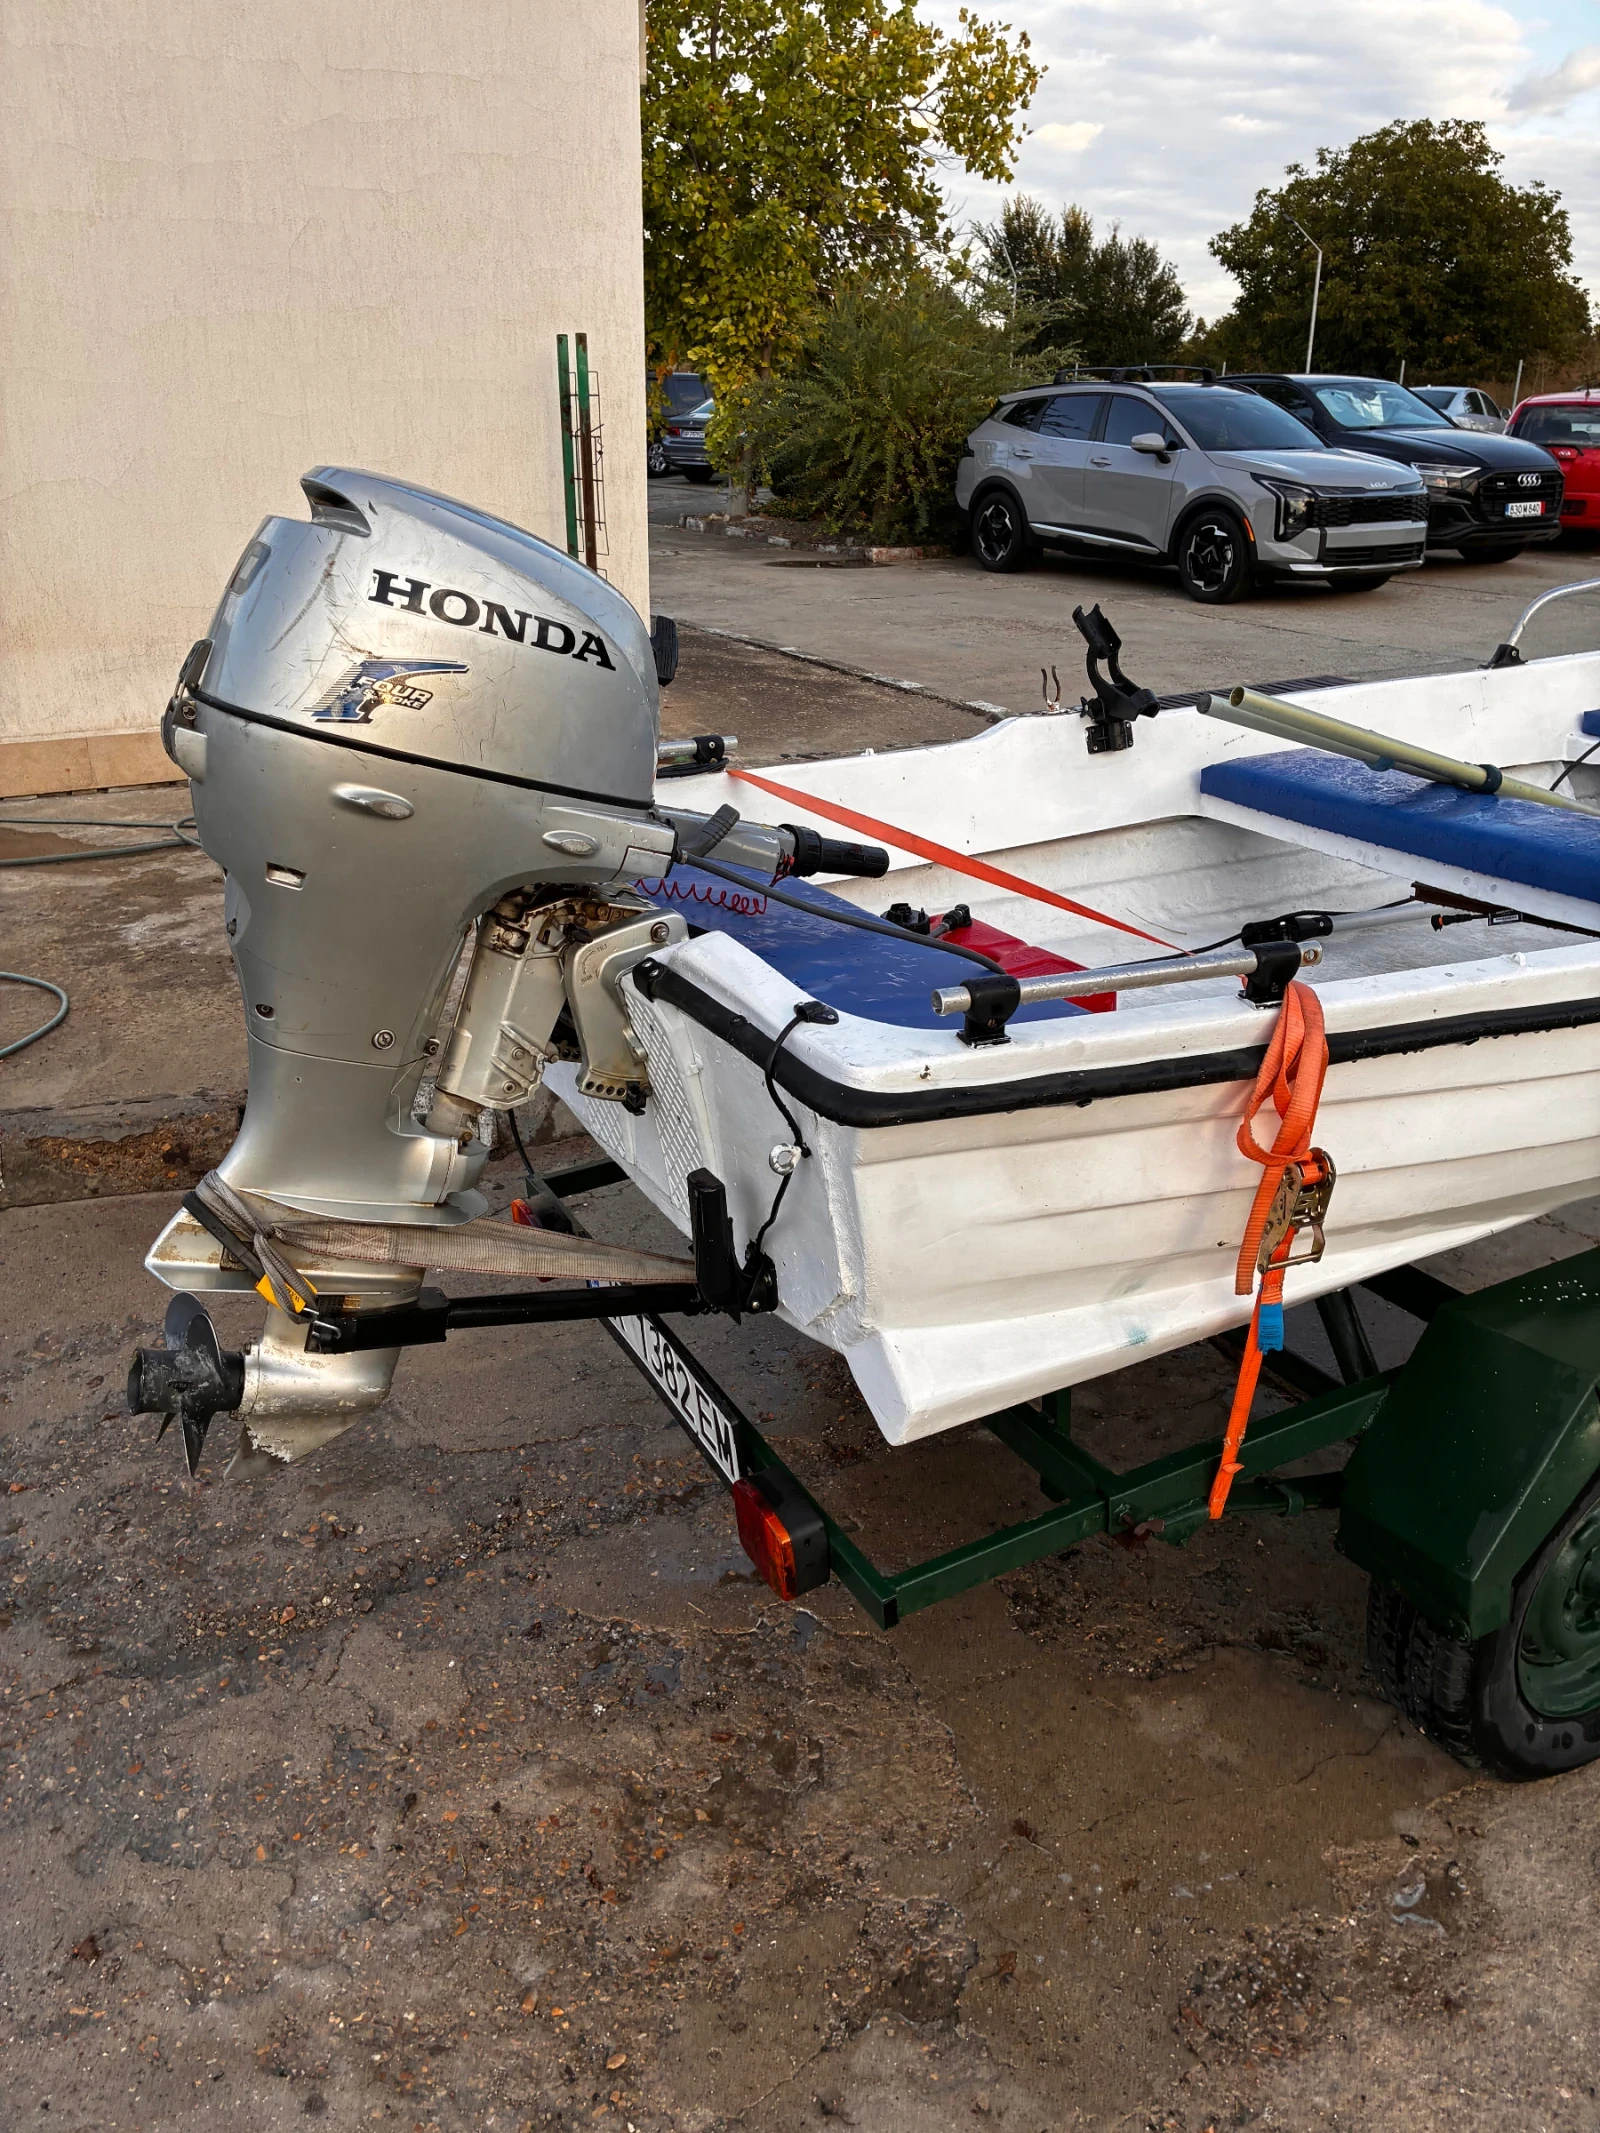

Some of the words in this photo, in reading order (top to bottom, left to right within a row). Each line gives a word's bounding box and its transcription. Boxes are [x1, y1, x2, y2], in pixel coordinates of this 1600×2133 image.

[368, 569, 617, 672] HONDA
[357, 676, 433, 703] FOUR
[608, 1283, 736, 1479] 1382EM
